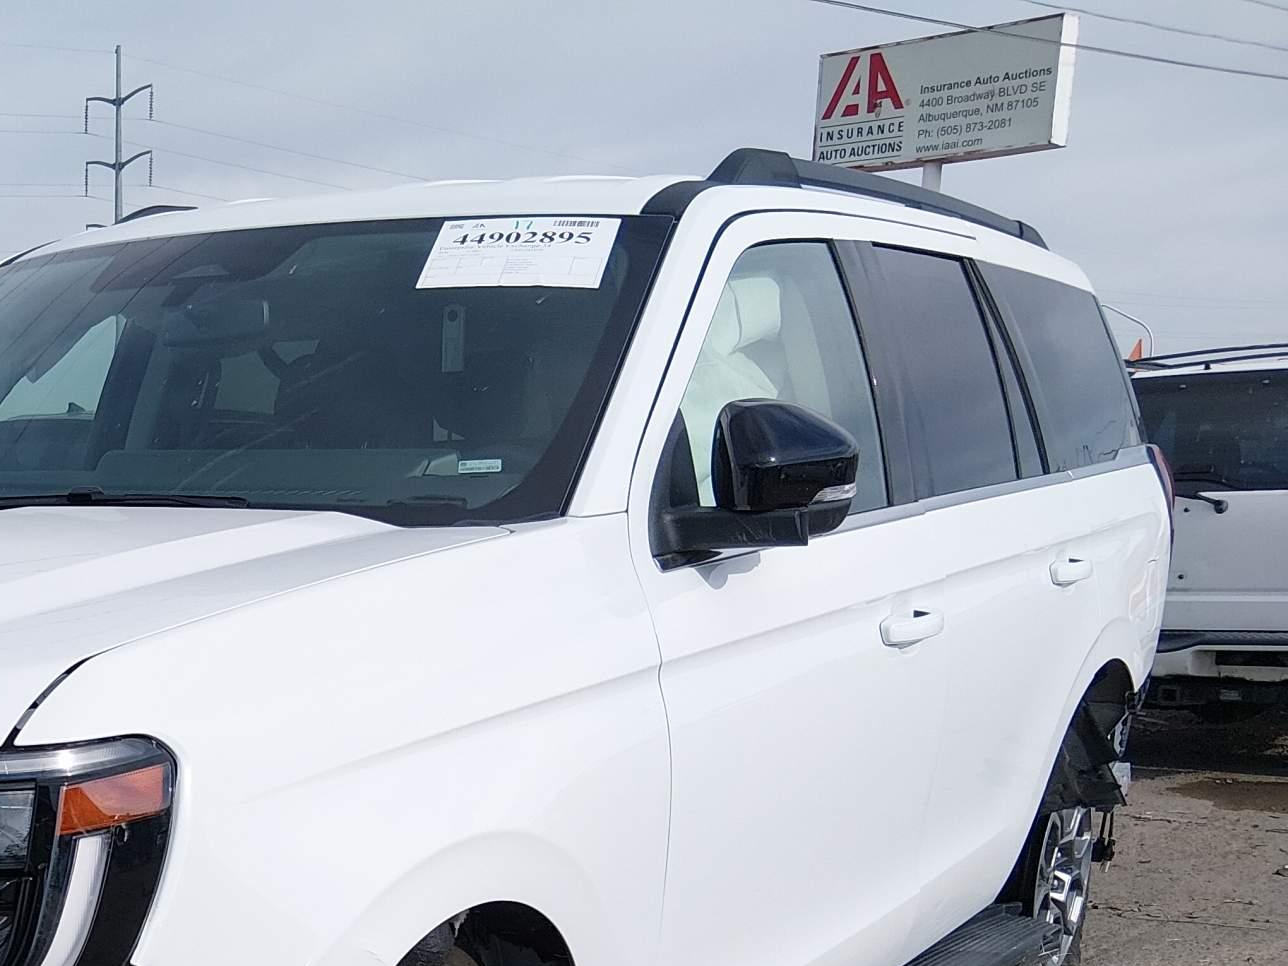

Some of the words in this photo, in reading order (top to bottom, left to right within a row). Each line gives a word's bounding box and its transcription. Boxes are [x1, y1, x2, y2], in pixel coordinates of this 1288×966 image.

[920, 79, 972, 95] Insurance
[974, 75, 1000, 87] Auto
[1002, 67, 1053, 82] Auctions
[919, 96, 944, 109] 4400
[946, 89, 996, 105] Broadway
[998, 84, 1028, 98] BLVD
[1031, 80, 1047, 93] SE
[918, 107, 983, 123] Albuquerque,
[986, 102, 1004, 113] NM
[1006, 97, 1039, 111] 87105
[819, 121, 905, 143] INSURANCE
[917, 129, 934, 139] Ph:
[936, 124, 963, 139] (505)
[965, 118, 1012, 133] 873-2081
[817, 148, 846, 162] AUTO
[848, 140, 904, 158] AUCTIONS
[915, 138, 983, 153] www.iaai.com
[452, 230, 594, 246] 44902895
